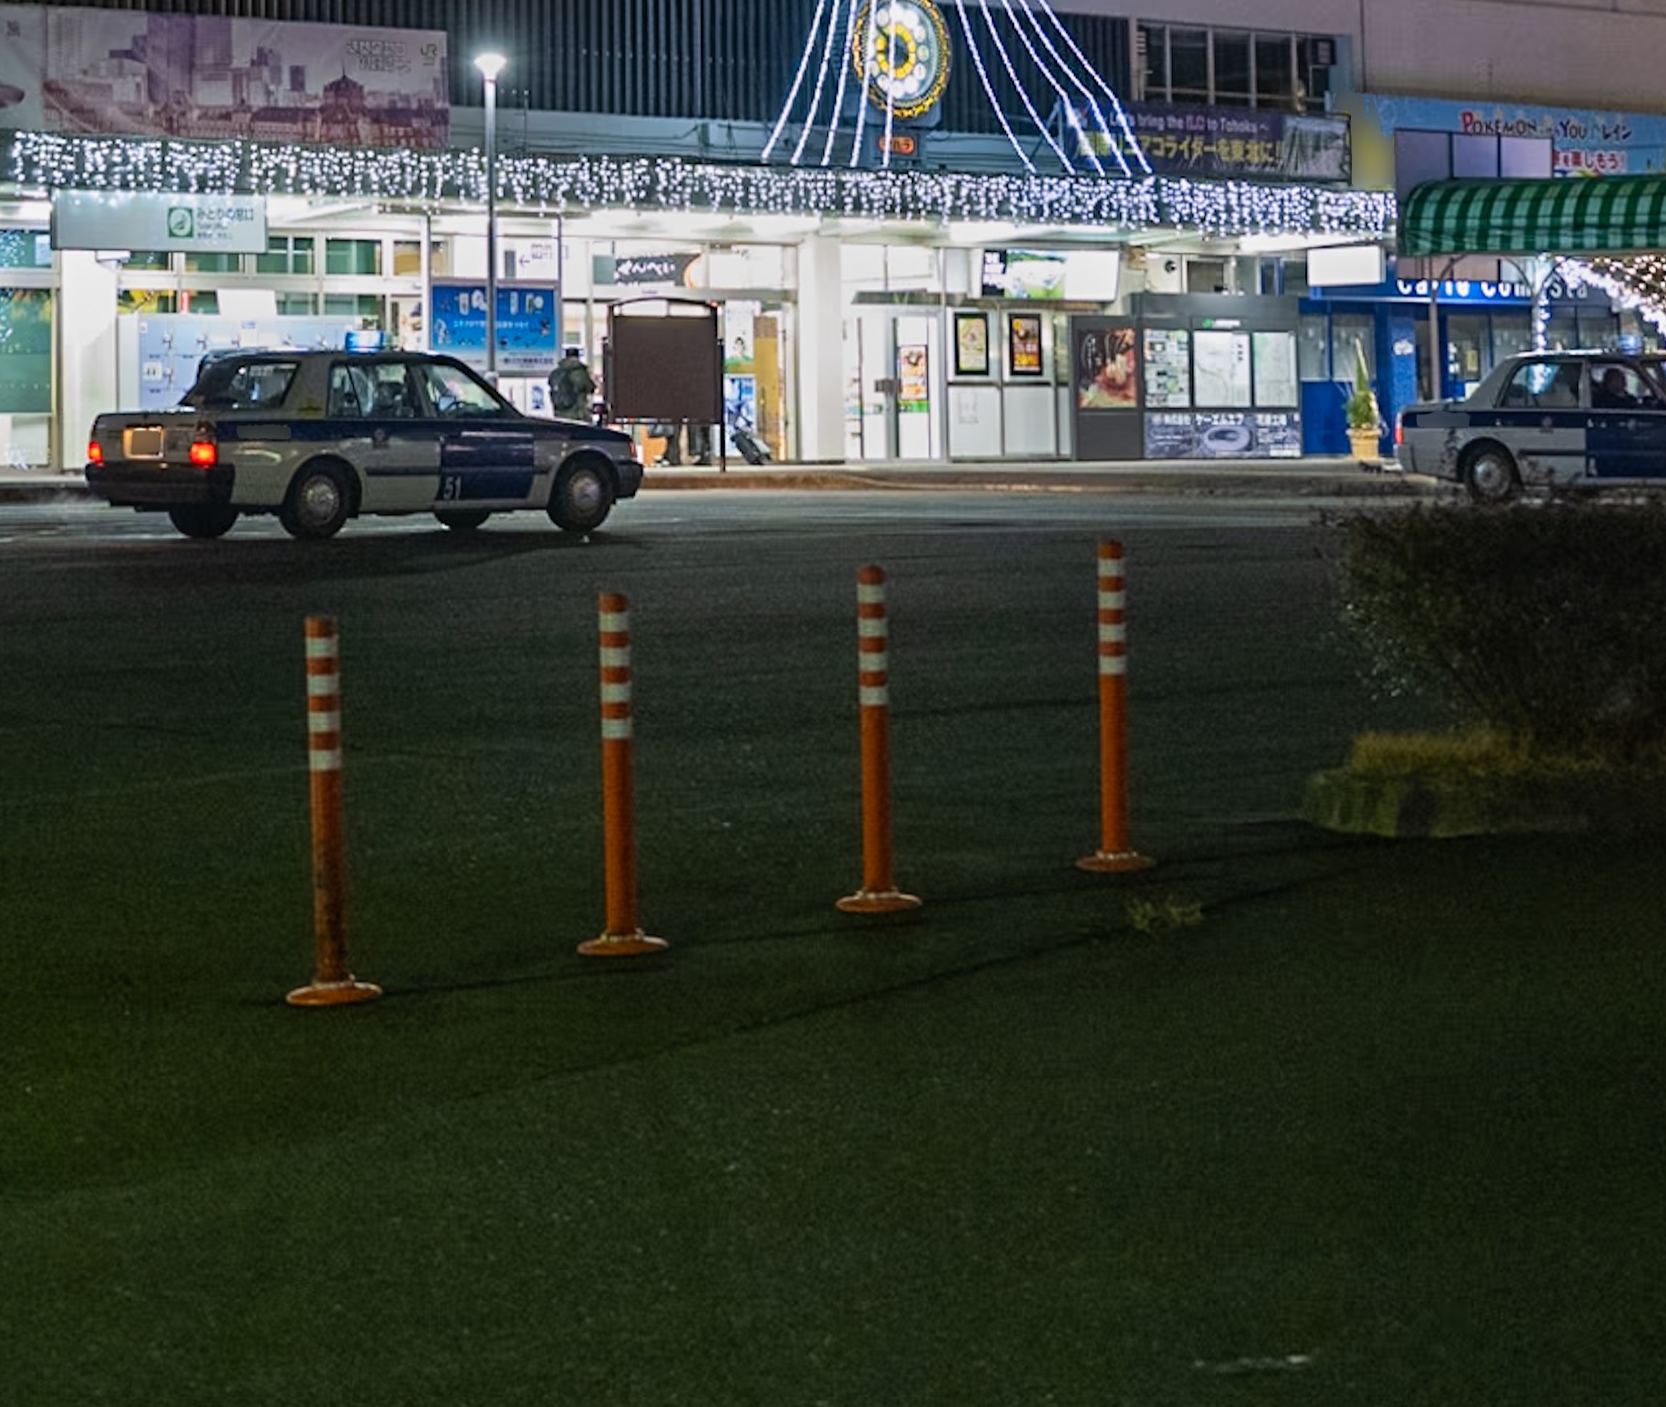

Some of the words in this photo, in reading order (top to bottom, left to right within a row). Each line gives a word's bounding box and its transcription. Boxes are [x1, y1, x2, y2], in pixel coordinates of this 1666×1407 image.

[1166, 115, 1184, 130] the
[1206, 117, 1219, 131] to
[1559, 120, 1587, 139] YOU
[196, 206, 254, 222] みどりの窓口
[443, 476, 462, 500] 51
